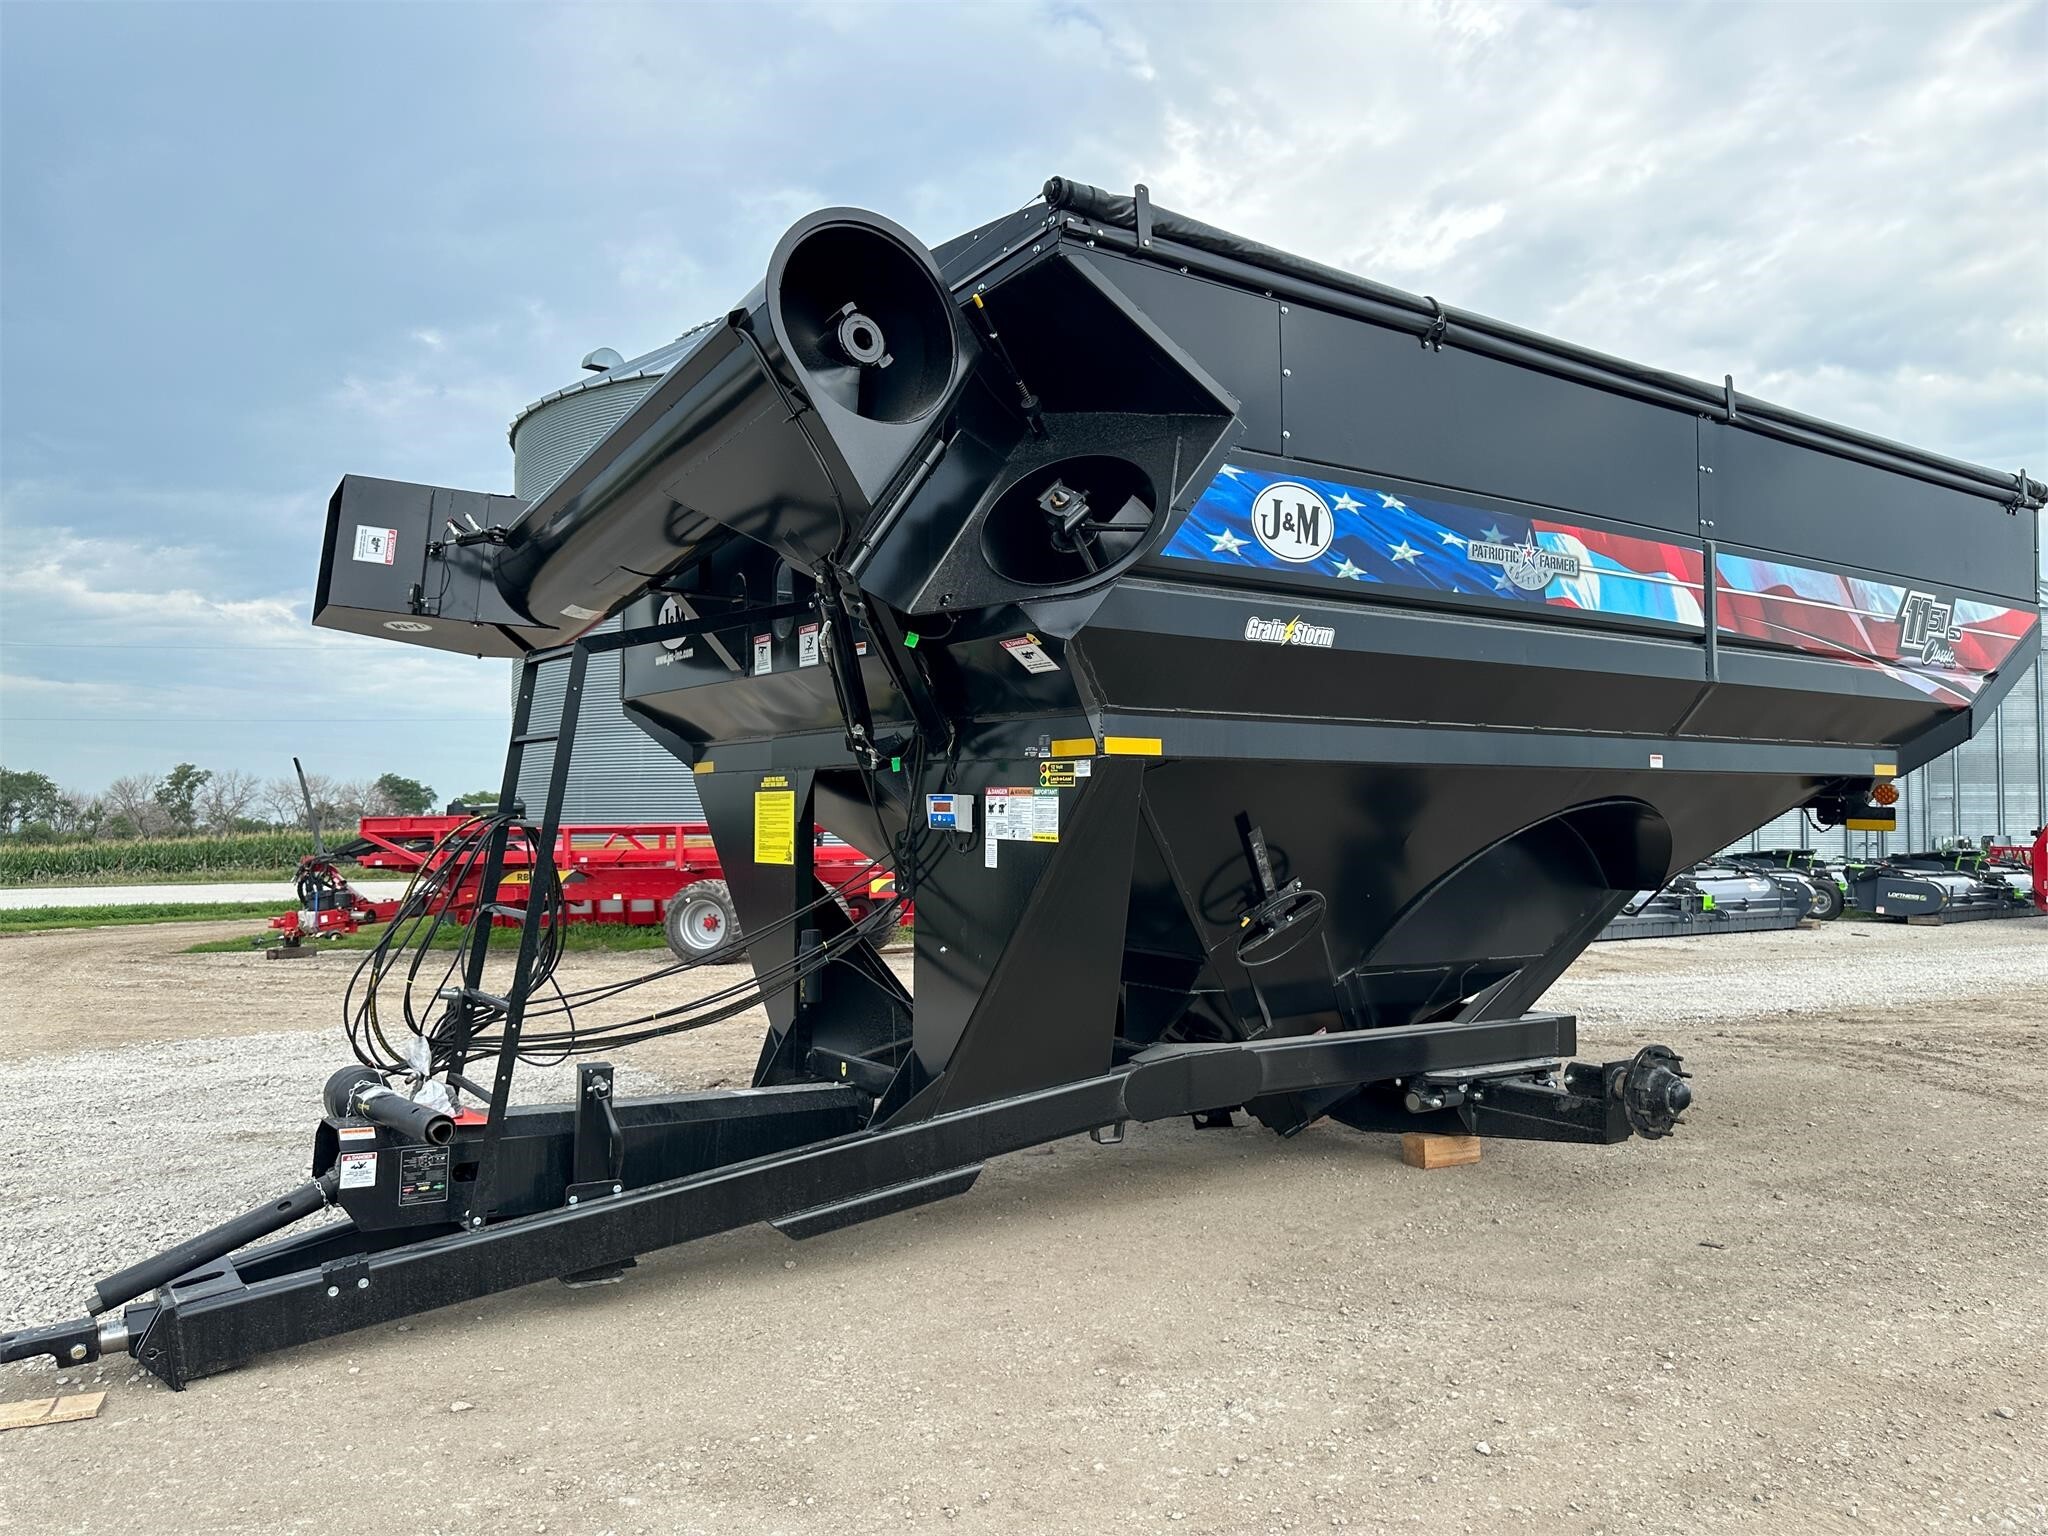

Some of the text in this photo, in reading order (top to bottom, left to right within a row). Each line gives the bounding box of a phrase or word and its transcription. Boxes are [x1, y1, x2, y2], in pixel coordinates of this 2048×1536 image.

[1261, 499, 1321, 547] J&M
[1471, 543, 1575, 572] PATRIOTIC FARMER
[1508, 566, 1548, 583] EDITION
[1922, 639, 1955, 665] Classic
